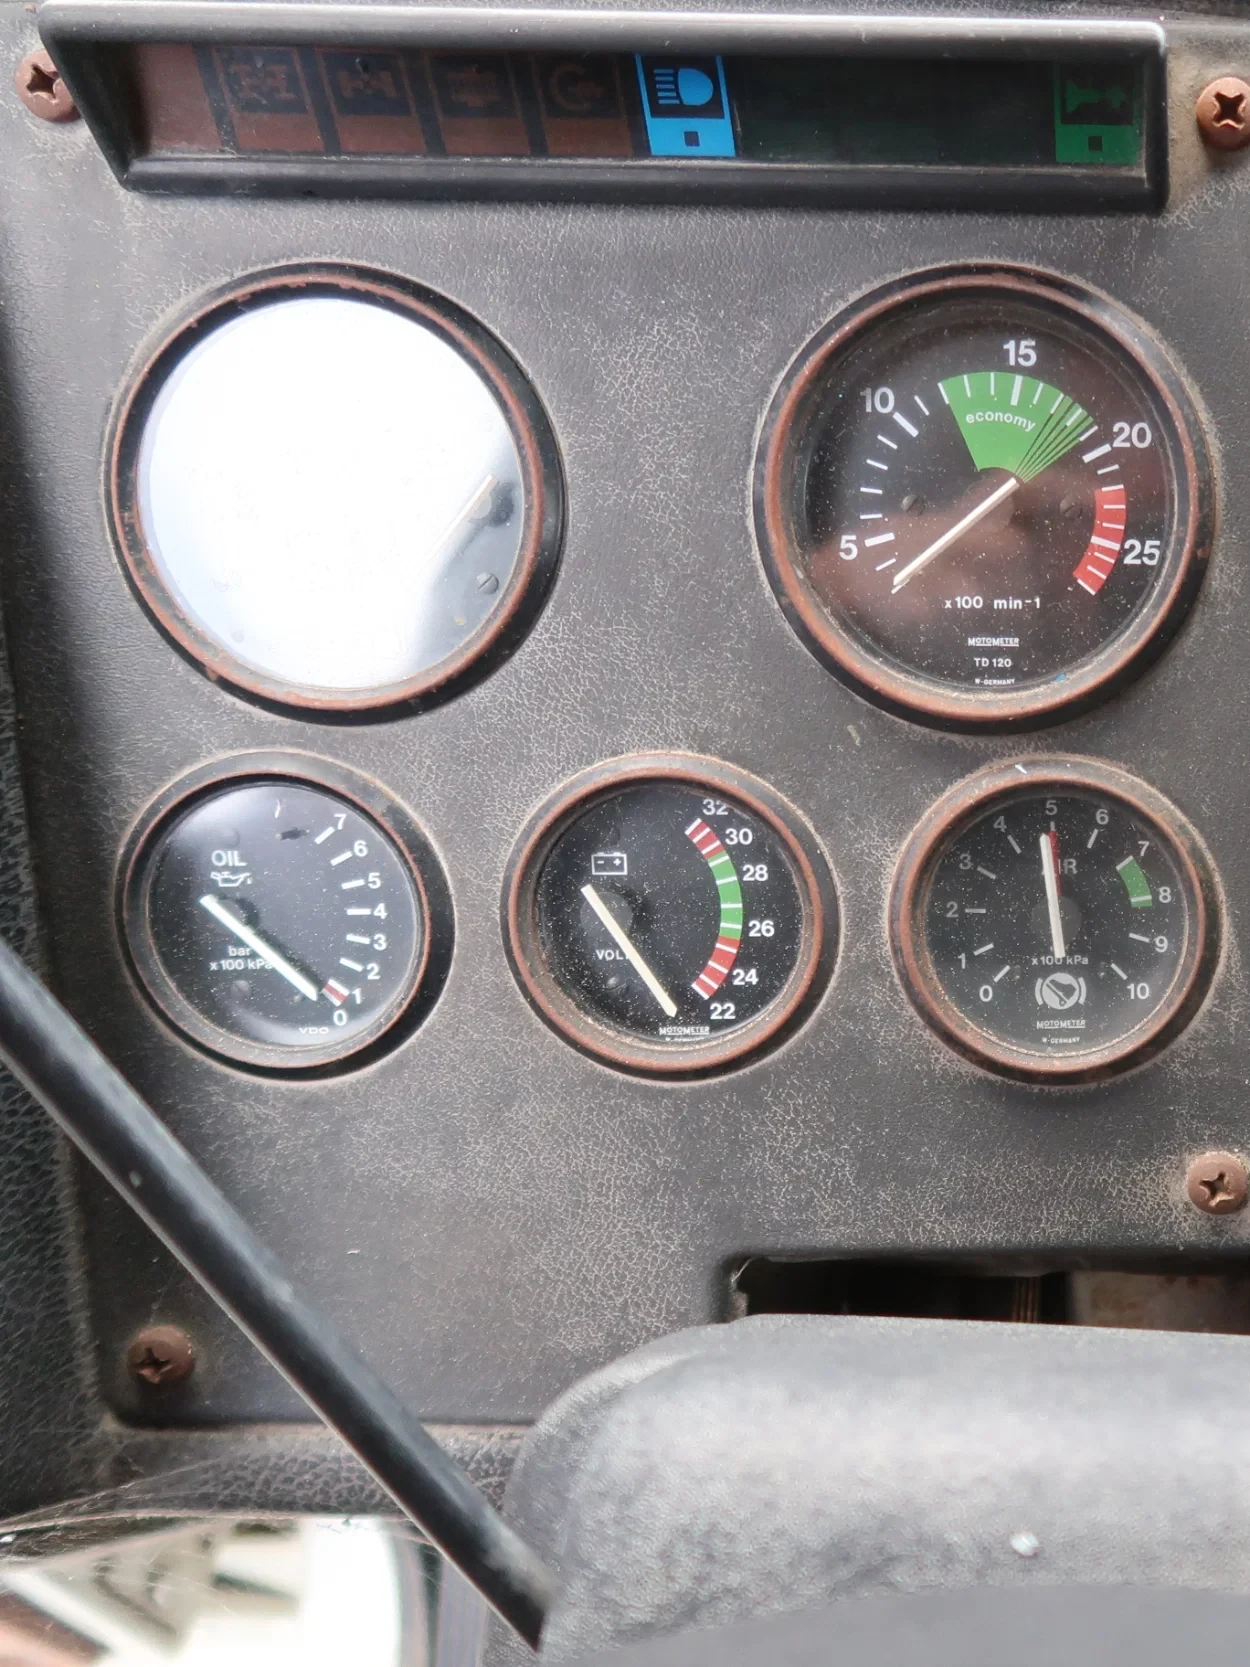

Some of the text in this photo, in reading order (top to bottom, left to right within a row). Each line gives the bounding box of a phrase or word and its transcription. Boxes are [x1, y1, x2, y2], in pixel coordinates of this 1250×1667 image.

[1003, 340, 1037, 366] 15
[863, 387, 895, 413] 10
[965, 411, 1036, 432] economy
[1112, 423, 1152, 448] 20
[839, 535, 858, 560] 5
[1124, 540, 1161, 565] 25
[974, 658, 1012, 668] TD 120
[702, 799, 728, 816] 32
[1045, 800, 1058, 816] 5
[334, 813, 347, 829] 7
[993, 815, 1006, 832] 4
[1095, 808, 1109, 825] 6
[725, 828, 753, 845] 30
[354, 840, 368, 857] 6
[1138, 841, 1150, 857] 7
[211, 851, 248, 867] OIL
[959, 854, 972, 870] 3
[368, 872, 381, 889] 5
[742, 865, 768, 882] 28
[1158, 887, 1172, 903] 8
[373, 903, 387, 919] 4
[946, 902, 959, 918] 2
[748, 921, 775, 937] 26
[373, 934, 387, 950] 3
[1155, 936, 1168, 953] 9
[228, 945, 252, 957] bar
[595, 949, 631, 960] VOL
[247, 959, 273, 970] kPa
[958, 953, 967, 969] 1
[1066, 954, 1089, 965] kPa
[367, 964, 380, 980] 2
[733, 969, 759, 986] 24
[352, 989, 362, 1004] 1
[979, 985, 993, 1002] 0
[1128, 983, 1150, 1000] 10
[333, 1010, 347, 1027] 0
[710, 1003, 736, 1020] 22
[298, 1027, 330, 1035] VDO
